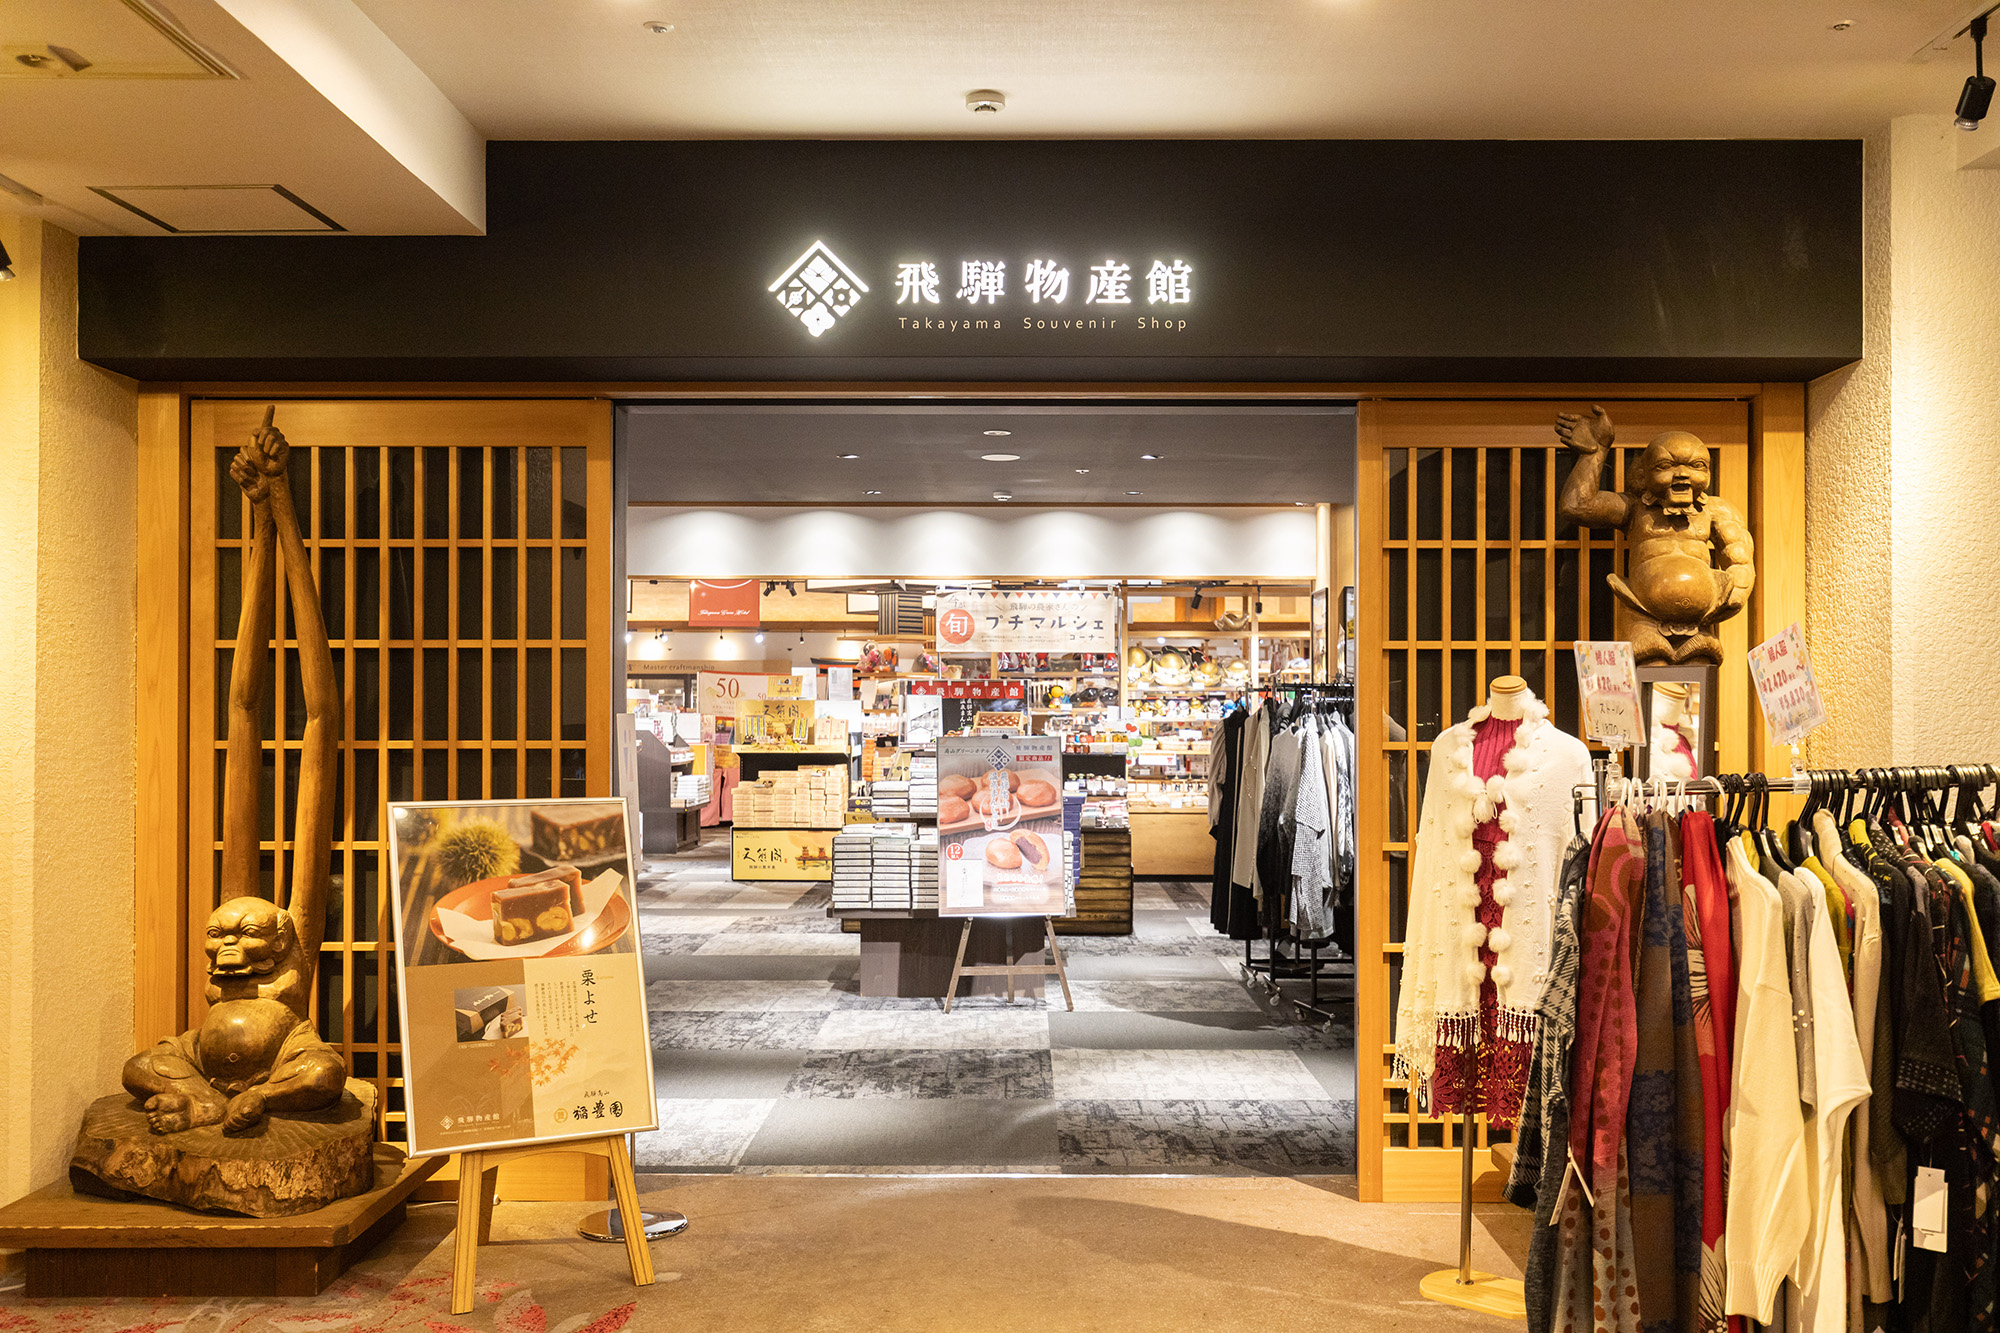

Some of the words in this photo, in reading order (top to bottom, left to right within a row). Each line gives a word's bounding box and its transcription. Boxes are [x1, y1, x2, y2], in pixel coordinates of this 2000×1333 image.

[895, 259, 1193, 304] 飛騨物産館
[898, 317, 1001, 333] Takayama
[1023, 317, 1117, 330] Souvenir
[1137, 317, 1188, 332] Shop
[945, 613, 968, 637] 旬
[986, 614, 1104, 631] プチマルシェ
[716, 677, 740, 698] 50
[936, 687, 1019, 697] 飛騨物産館
[950, 845, 960, 854] 12
[581, 969, 598, 1024] 栗よせ
